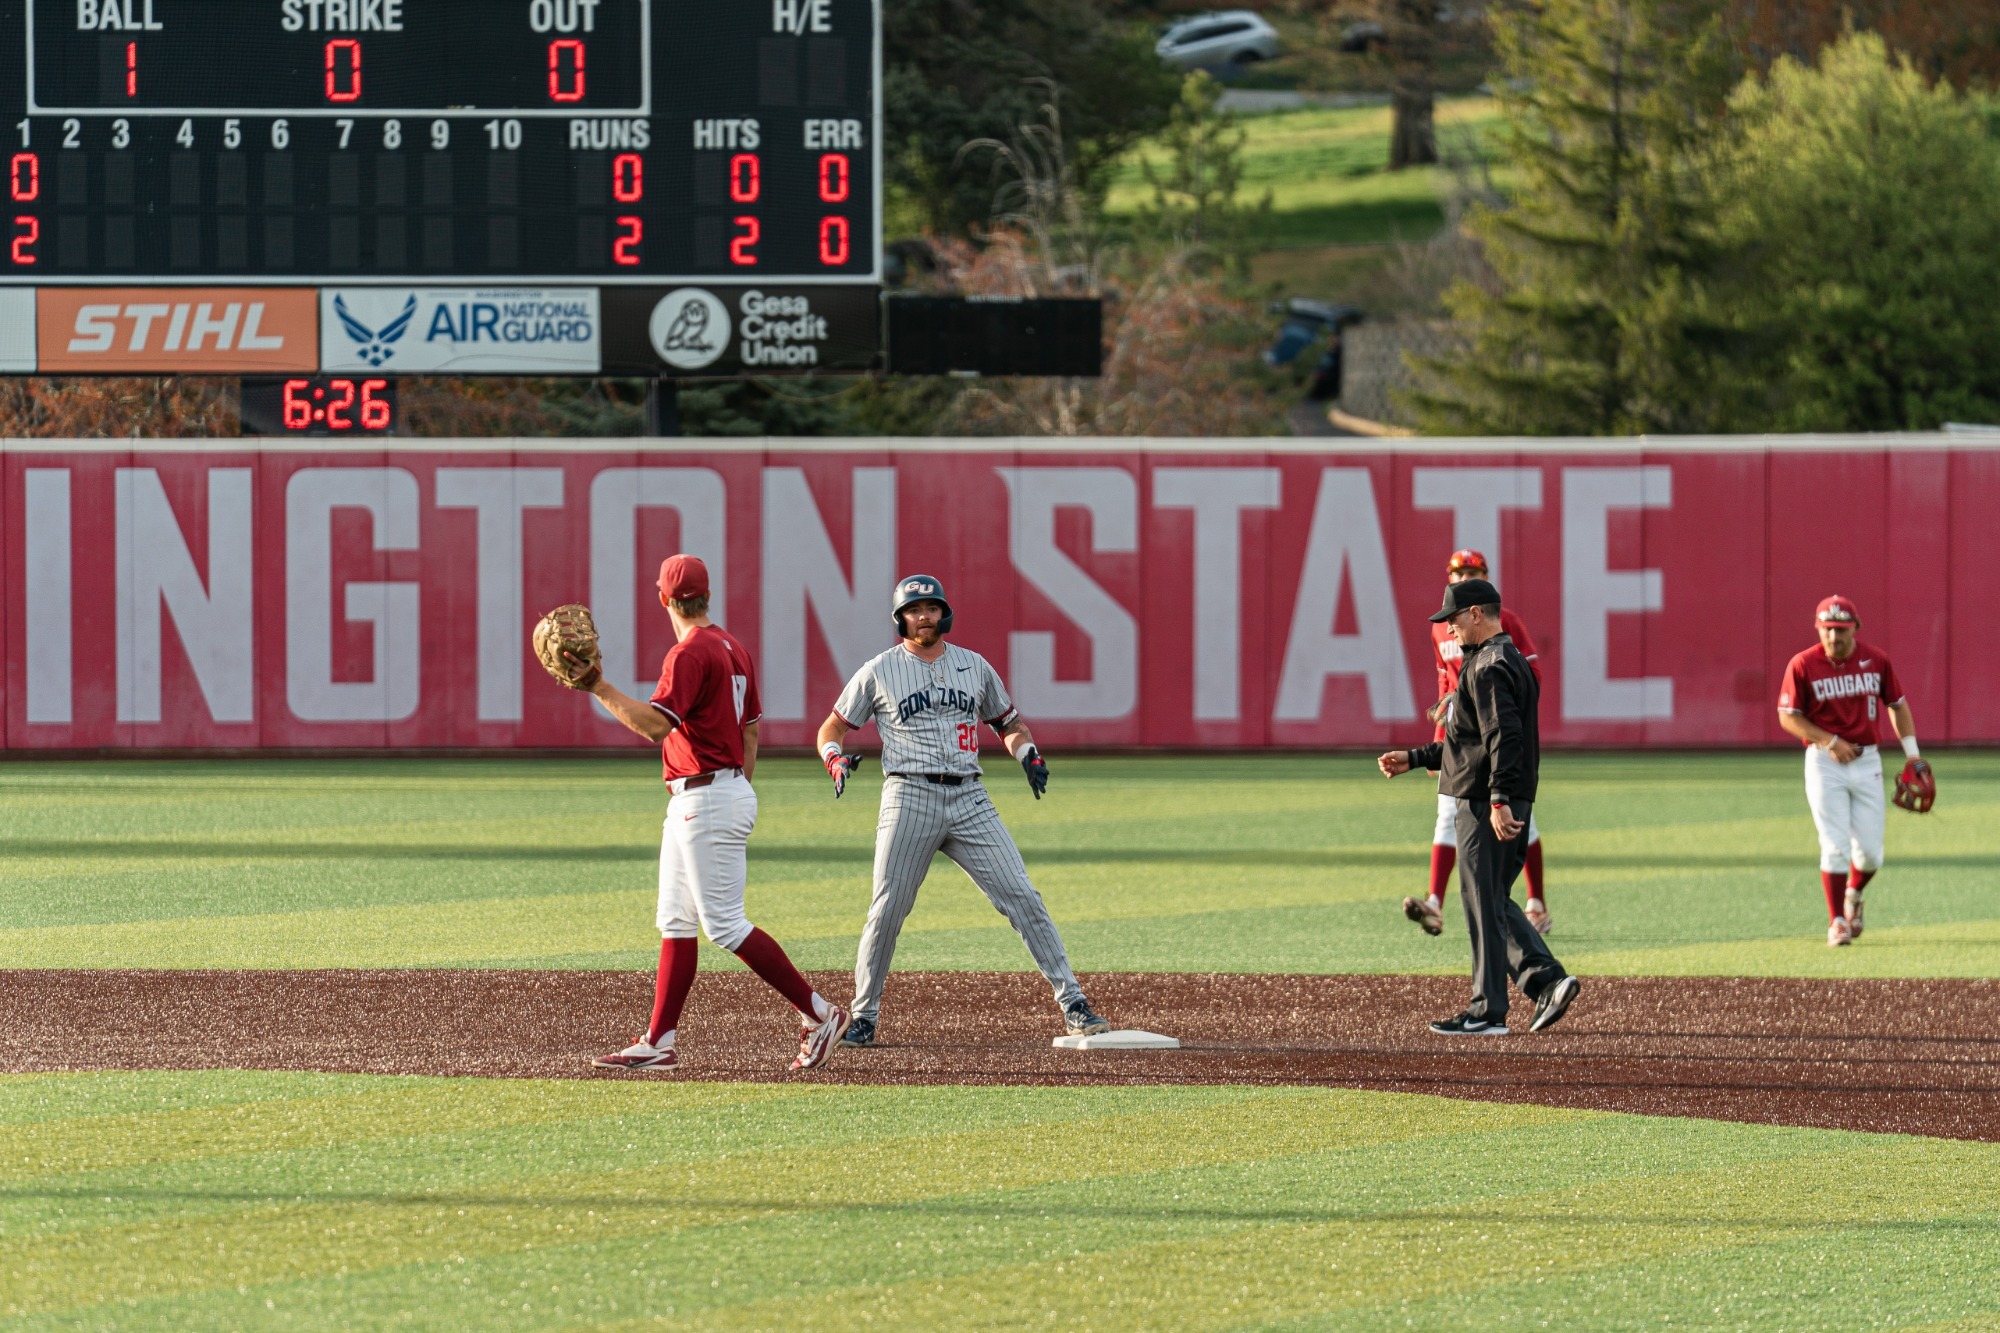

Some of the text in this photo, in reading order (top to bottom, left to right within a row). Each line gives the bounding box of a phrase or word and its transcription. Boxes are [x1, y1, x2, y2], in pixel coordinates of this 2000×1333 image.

[77, 0, 831, 35] BALL STRIKE OUT H/E
[127, 39, 585, 101] 1 0 0
[17, 119, 862, 150] 1 2 3 4 5 6 7 8 9 10 RUNS HITS ERR
[11, 153, 849, 202] 0 0 0 0
[11, 216, 849, 265] 2 2 2 0
[740, 290, 809, 315] Gesa
[67, 302, 284, 352] STIHL
[426, 302, 591, 342] AIR NATIONAL
[503, 320, 592, 342] GUARD
[740, 315, 828, 341] Credit
[741, 341, 817, 365] Union
[283, 379, 390, 429] 6:26
[25, 465, 1675, 722] INGTON STATE
[904, 581, 934, 595] GU
[1812, 672, 1881, 702] COUGARS
[1867, 694, 1876, 721] 6
[957, 723, 978, 752] 20
